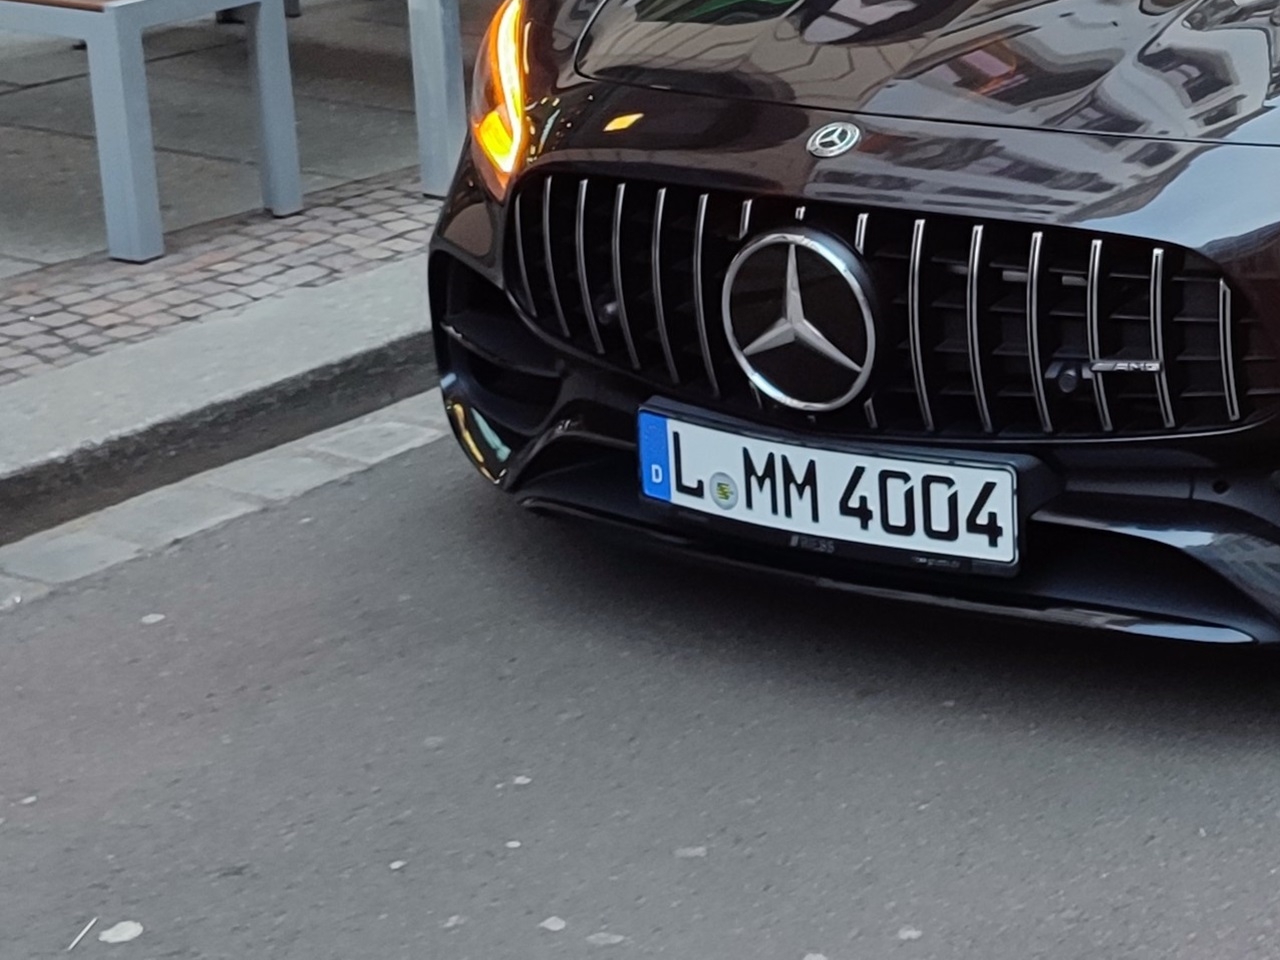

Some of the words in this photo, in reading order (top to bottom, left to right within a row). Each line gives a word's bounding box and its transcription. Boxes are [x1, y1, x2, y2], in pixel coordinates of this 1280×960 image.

[651, 464, 663, 483] D
[673, 431, 704, 499] L
[742, 447, 819, 523] MM
[839, 466, 1003, 547] 4004
